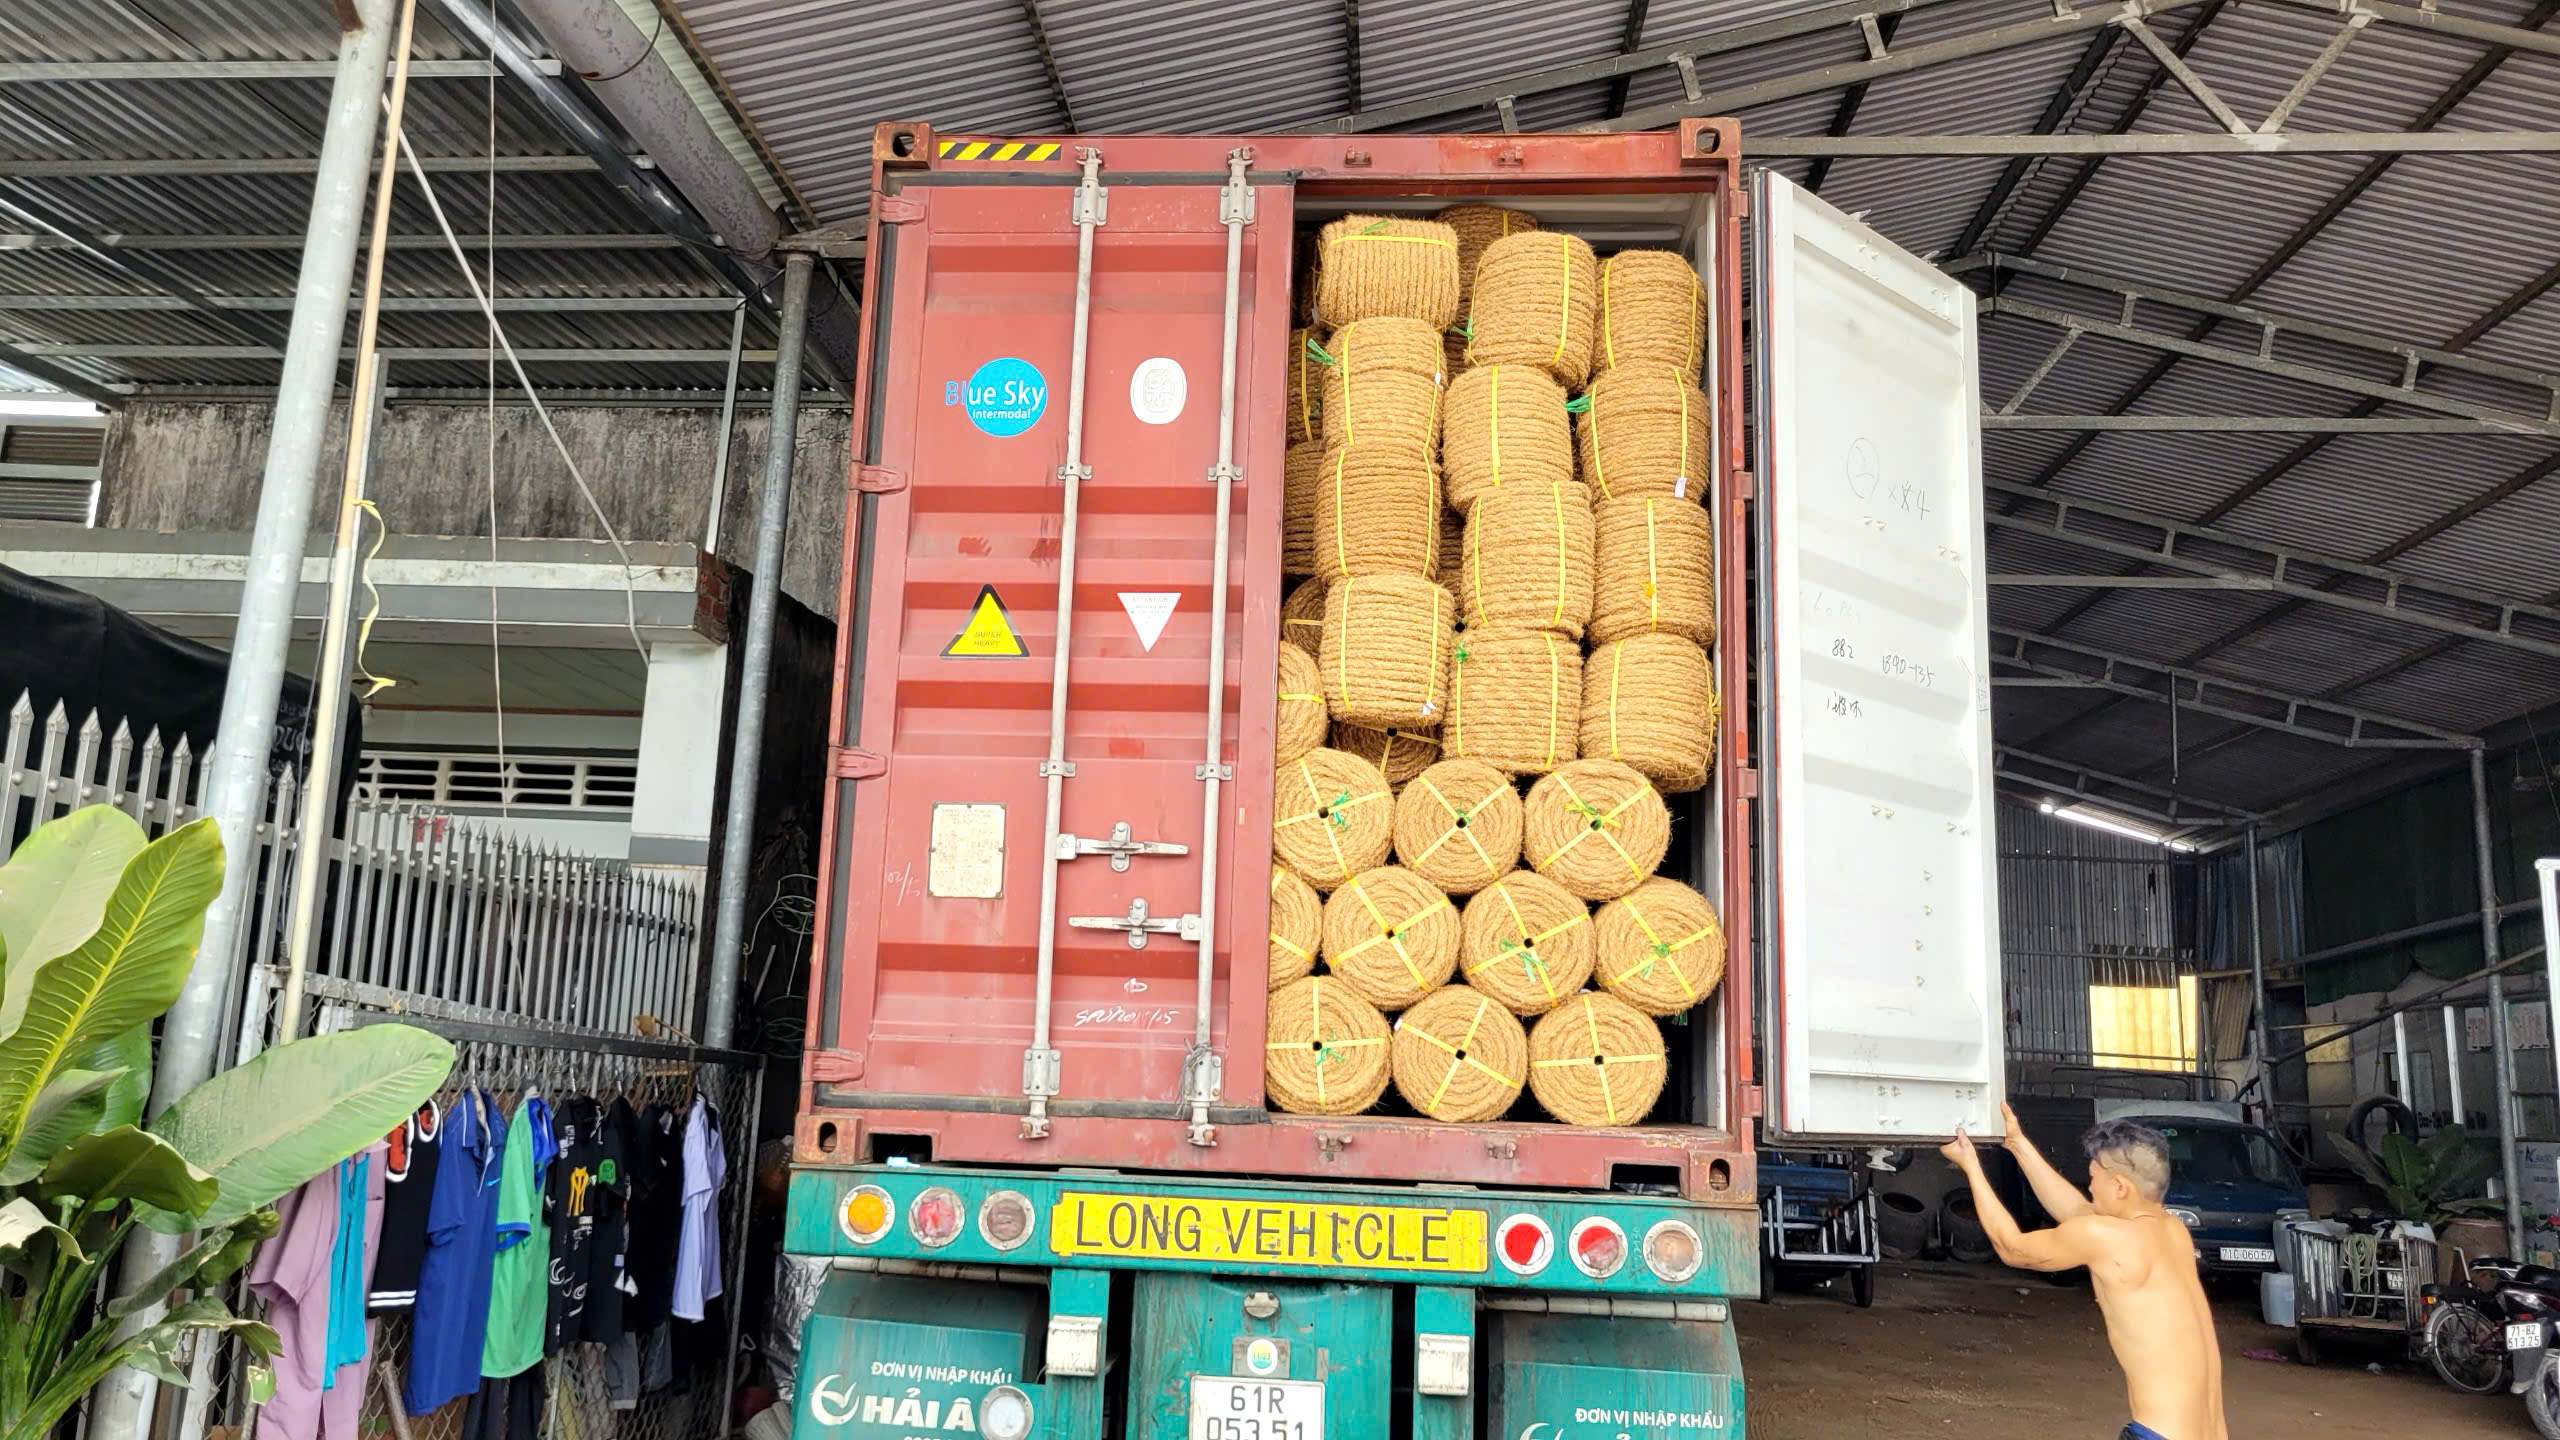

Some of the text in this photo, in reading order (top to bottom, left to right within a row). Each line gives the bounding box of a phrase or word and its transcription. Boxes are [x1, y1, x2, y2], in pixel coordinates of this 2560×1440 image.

[945, 379, 1045, 411] Blue Sky
[1076, 1200, 1449, 1264] LONG VEHICLE
[871, 1361, 906, 1377] ĐƠN
[908, 1364, 922, 1383] VỊ
[925, 1365, 968, 1385] NHẬP
[861, 1386, 976, 1433] HẢI Â
[1230, 1385, 1285, 1414] 61R
[1575, 1407, 1611, 1424] ĐƠN
[1613, 1410, 1630, 1429] VỊ
[1633, 1410, 1677, 1430] NHẬP
